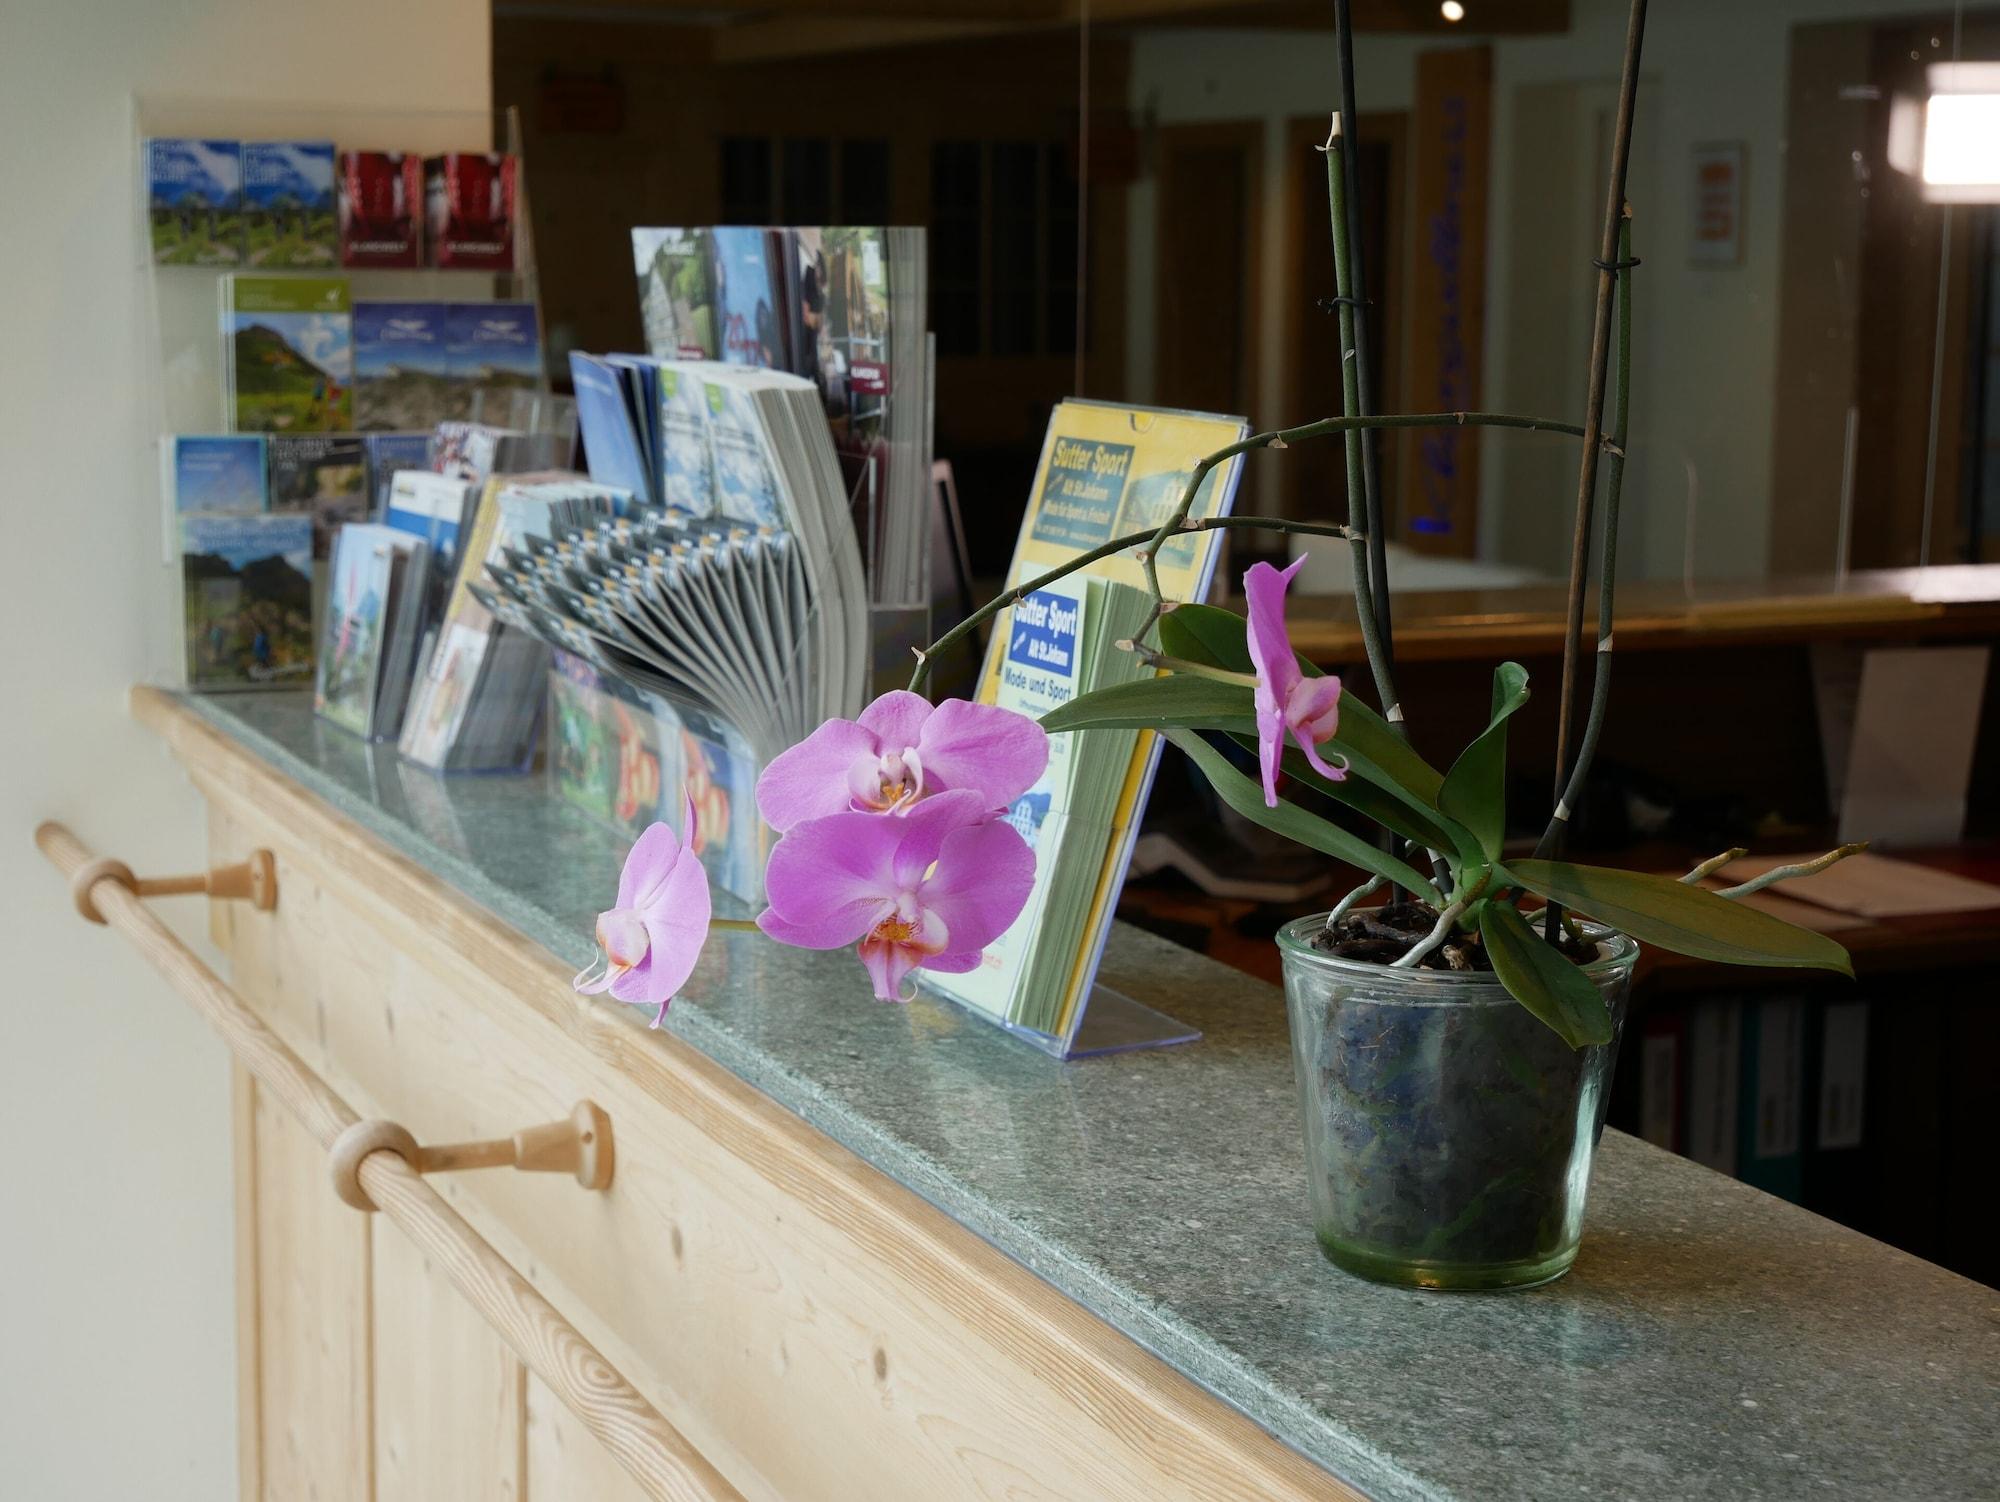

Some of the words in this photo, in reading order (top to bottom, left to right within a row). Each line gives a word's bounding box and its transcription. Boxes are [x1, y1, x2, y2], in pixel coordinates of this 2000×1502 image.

[1053, 440, 1092, 471] Sutter
[1092, 444, 1129, 480] Sport
[1048, 600, 1076, 638] Sport
[1004, 667, 1026, 689] Mode
[1029, 676, 1045, 694] und
[1048, 679, 1071, 702] Sport
